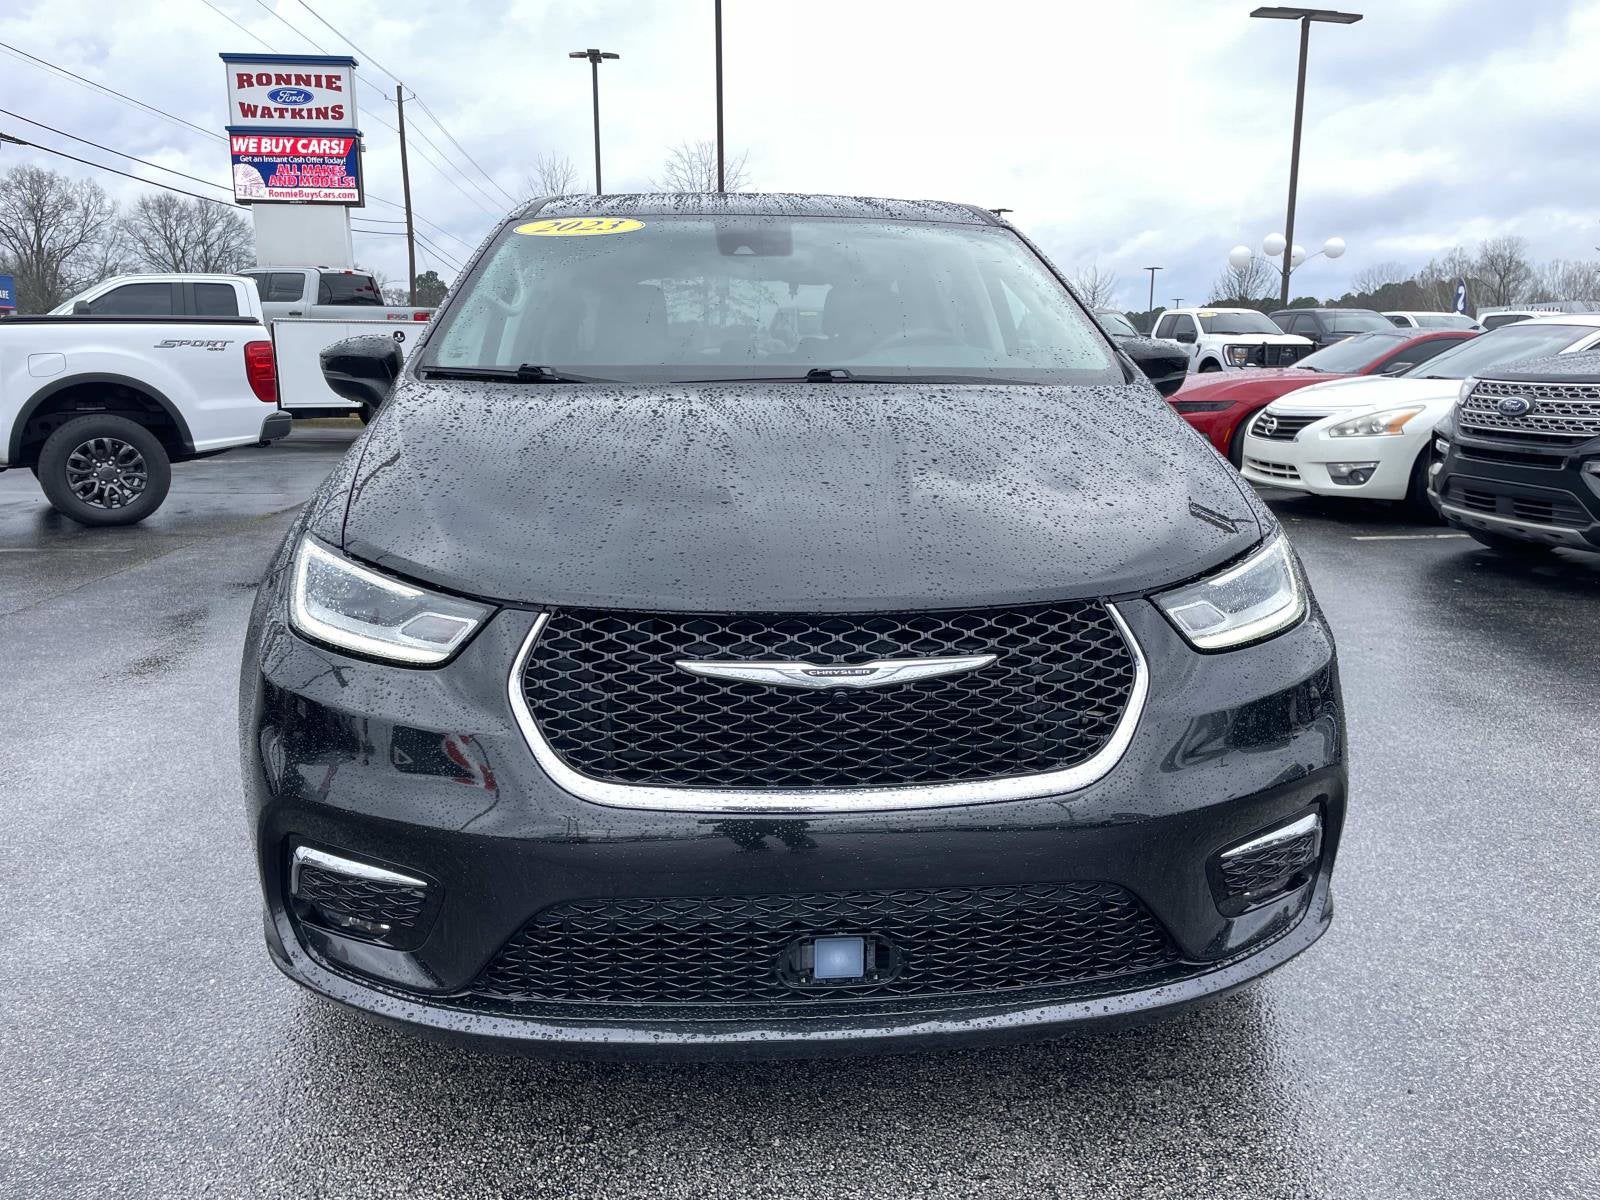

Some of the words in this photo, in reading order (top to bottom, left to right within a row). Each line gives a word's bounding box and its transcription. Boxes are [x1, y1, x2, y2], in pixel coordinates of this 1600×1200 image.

[236, 73, 342, 92] RONNIE
[277, 90, 304, 103] Ford
[238, 101, 344, 121] WATKINS
[232, 138, 258, 153] WE
[261, 138, 294, 153] BUY
[297, 139, 345, 154] CARS!
[240, 155, 252, 163] Get
[263, 155, 288, 163] Instant
[289, 156, 305, 164] Cash
[306, 156, 323, 164] Offer
[324, 157, 347, 166] Today!
[276, 163, 300, 175] ALL
[301, 164, 346, 176] MAKES
[268, 175, 297, 187] AND
[299, 176, 355, 188] MODELS!
[268, 189, 356, 200] RonnieBuysCars.com
[534, 220, 626, 233] 2023
[153, 339, 235, 349] SPORT
